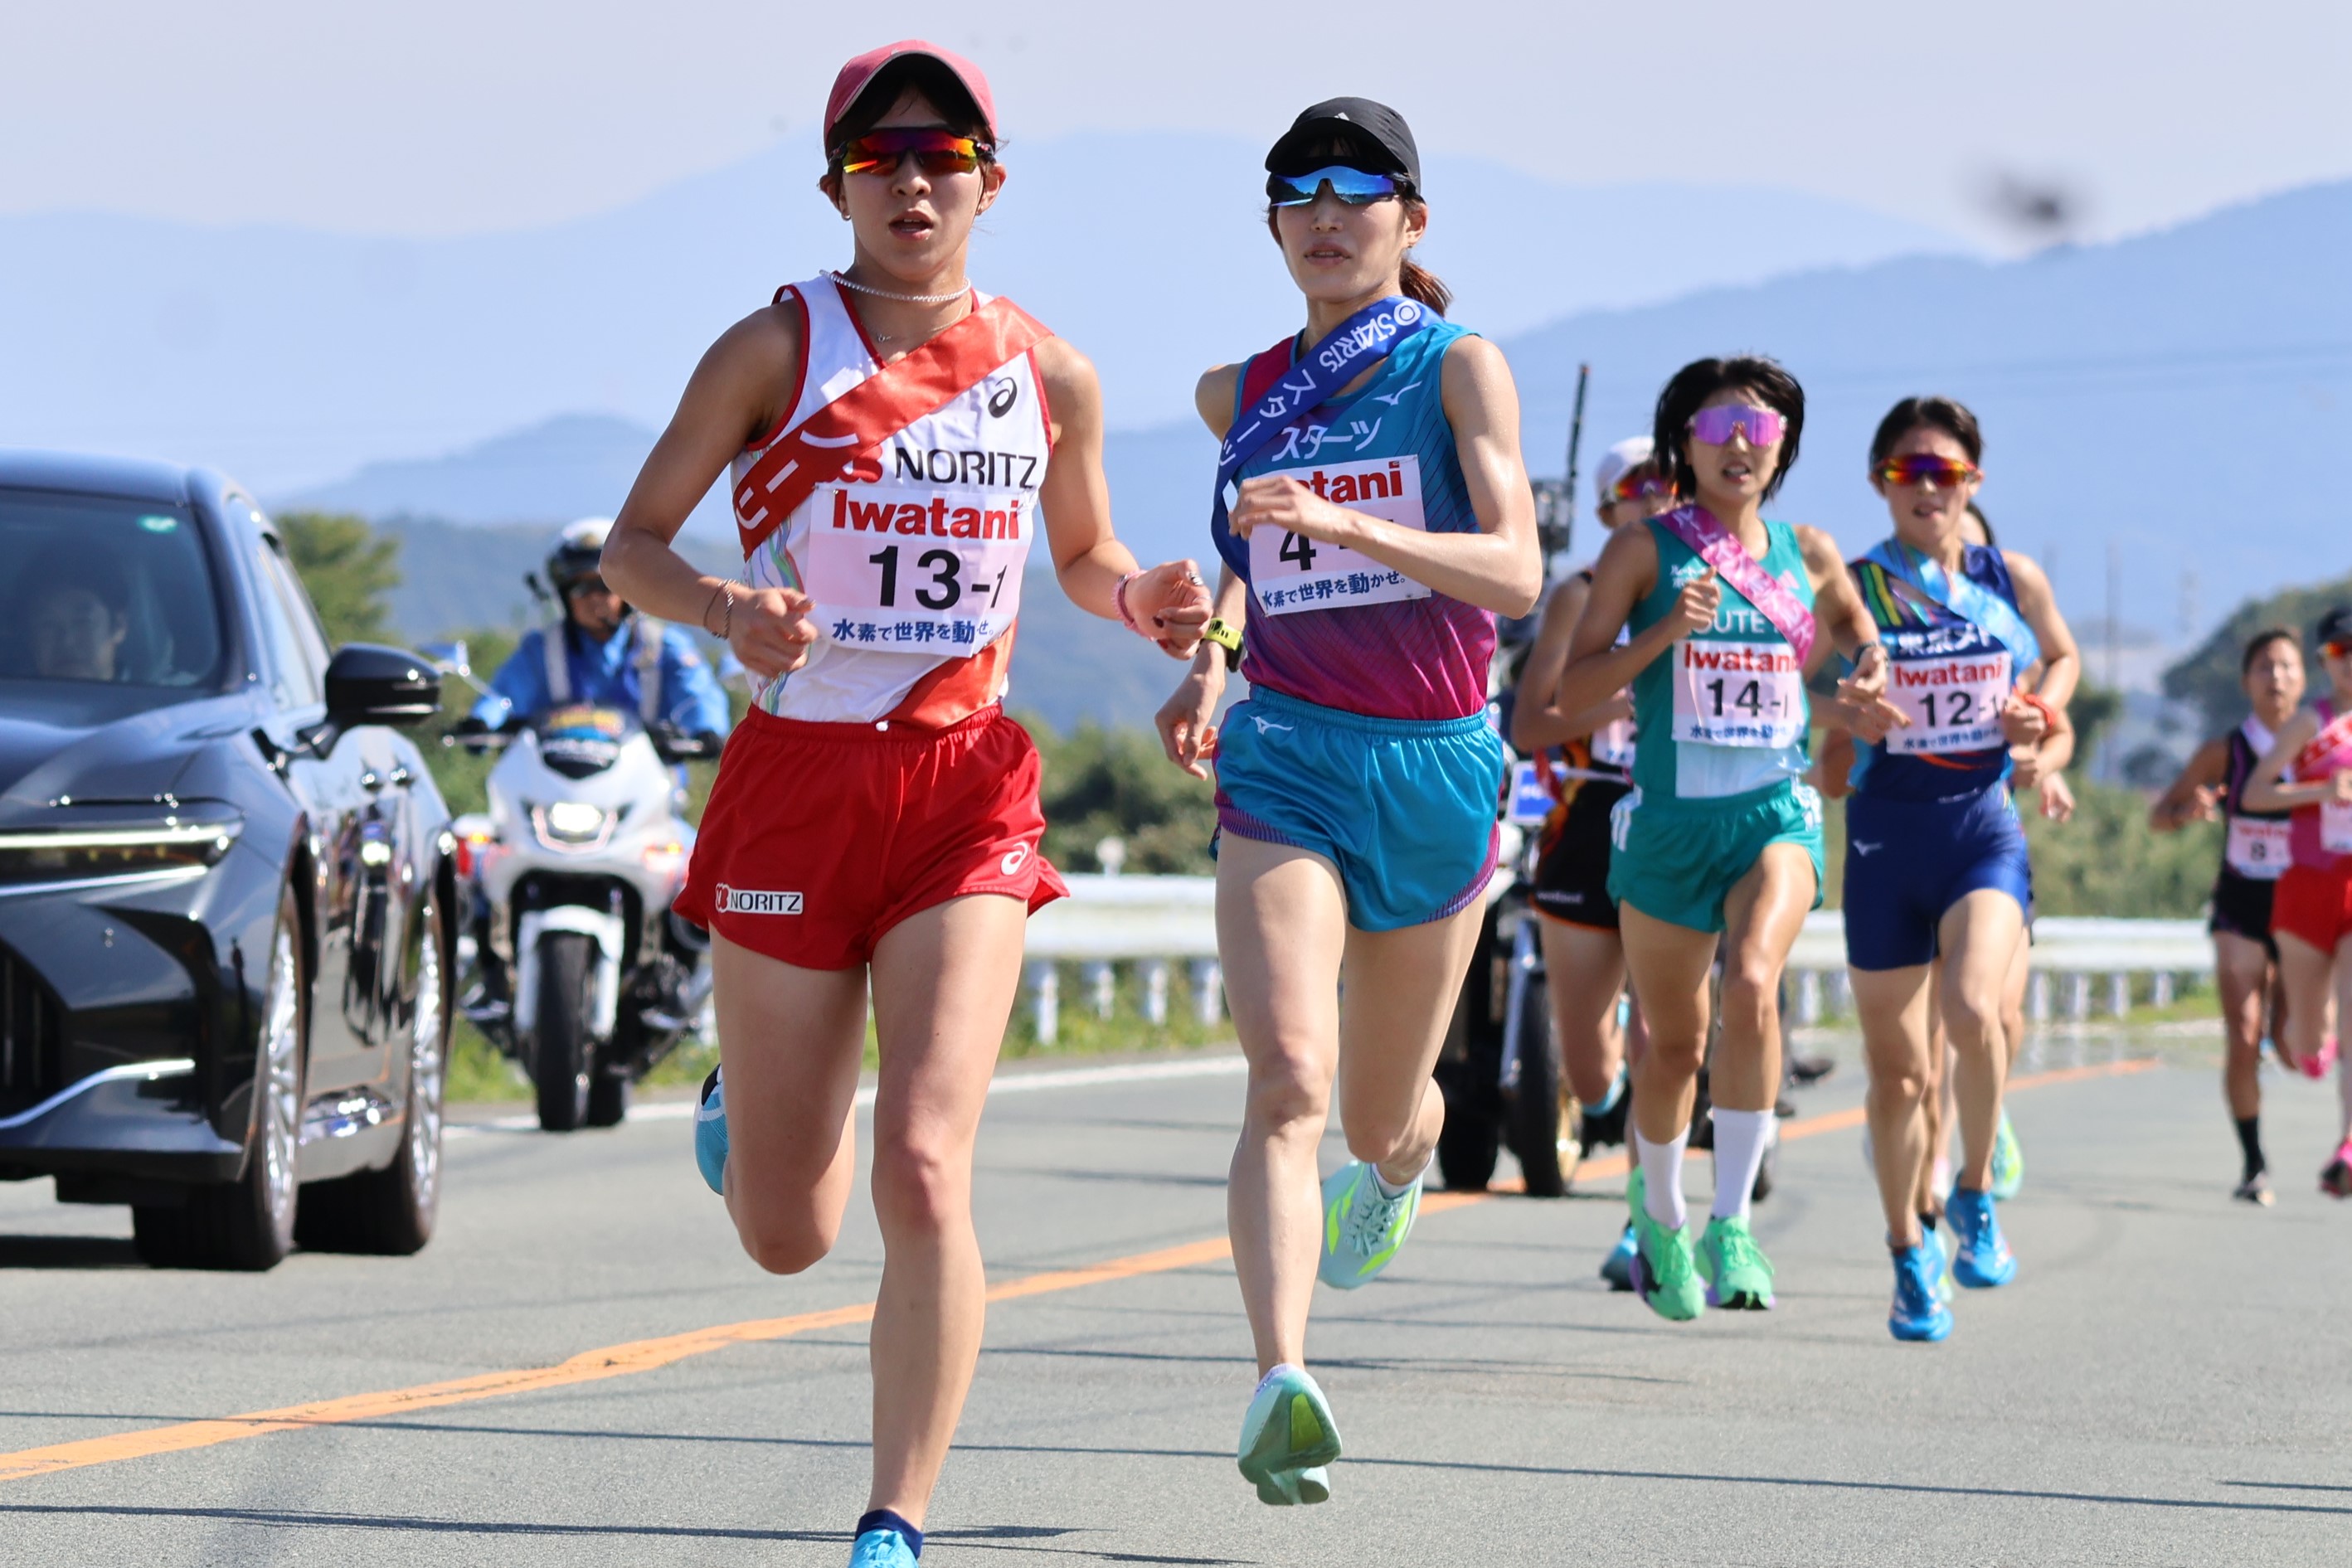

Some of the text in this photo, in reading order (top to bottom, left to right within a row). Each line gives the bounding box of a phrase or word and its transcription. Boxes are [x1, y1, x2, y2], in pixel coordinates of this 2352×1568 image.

[1271, 416, 1382, 462] スターツ
[896, 447, 1037, 488] NORITZ
[833, 489, 1019, 540] Iwatani
[869, 545, 1008, 610] 13-1
[1261, 570, 1406, 610] 水素で世界を動かせ。
[1894, 656, 2003, 688] Iwatani
[730, 891, 801, 912] NORITZ
